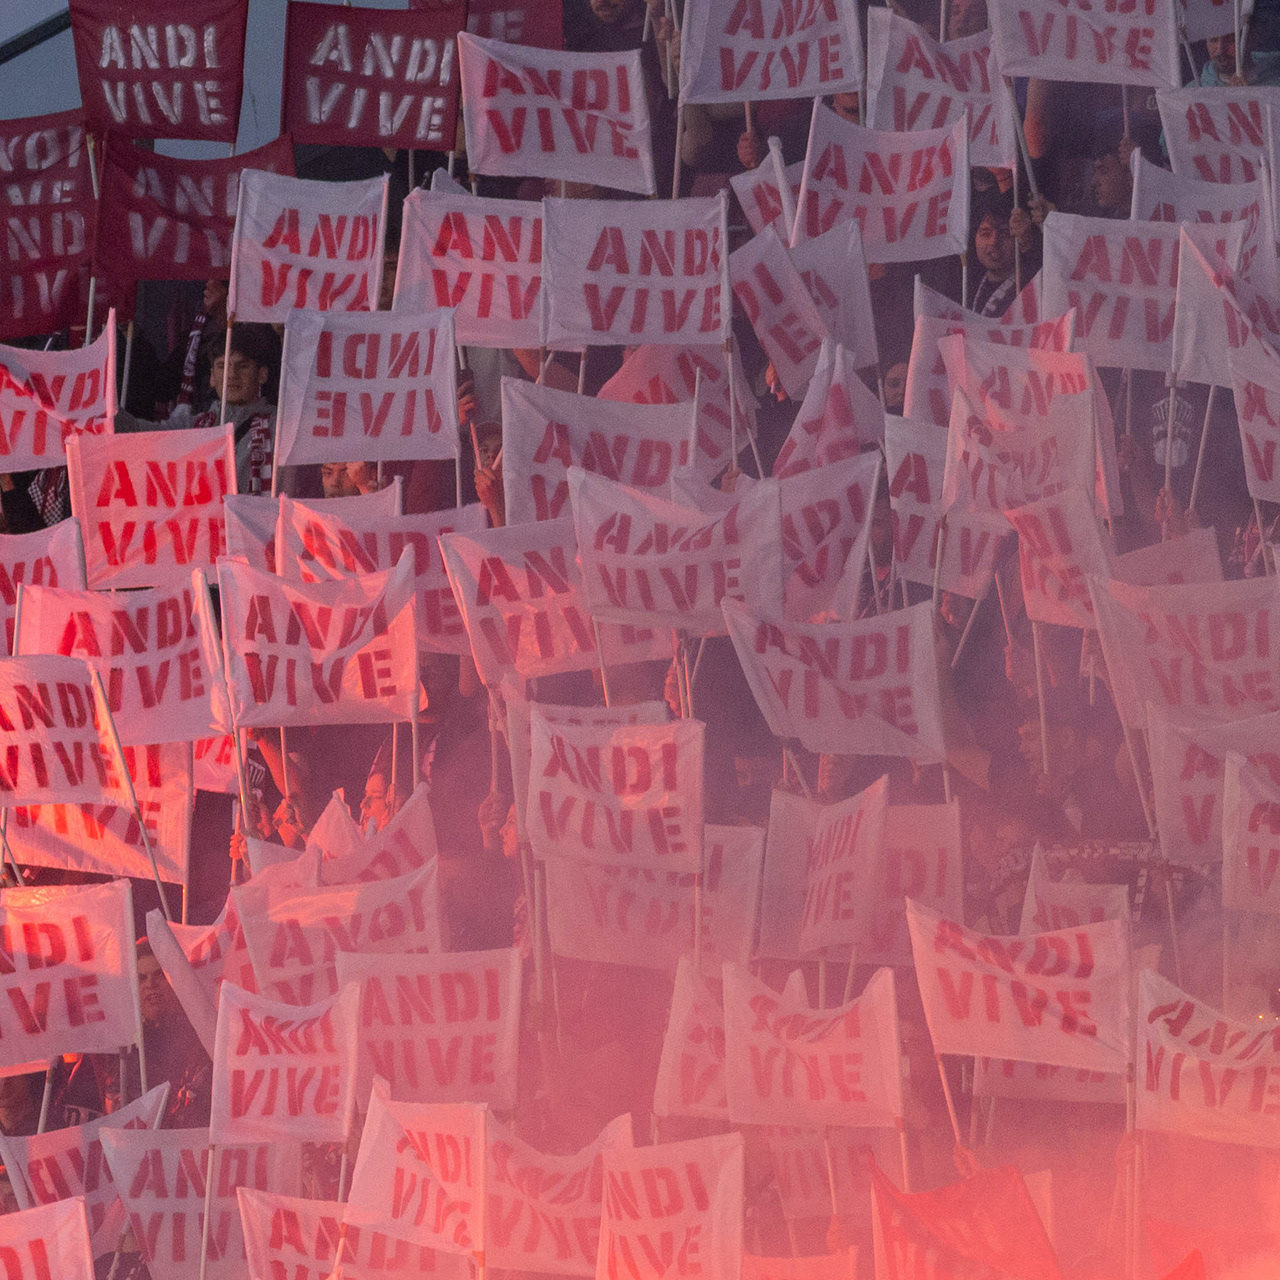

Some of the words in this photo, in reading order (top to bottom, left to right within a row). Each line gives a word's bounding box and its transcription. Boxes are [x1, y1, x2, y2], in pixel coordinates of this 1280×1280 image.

[102, 24, 220, 68] ANDI
[311, 25, 454, 86] ANDI
[721, 36, 842, 91] VIVE
[1020, 12, 1155, 70] VIVE
[100, 80, 226, 125] VIVE
[306, 76, 445, 141] VIVE
[482, 61, 632, 112] ANDI
[486, 108, 638, 158] VIVE
[262, 208, 378, 261] ANDI
[805, 192, 950, 244] VIVE
[260, 260, 371, 311] VIV
[584, 284, 721, 332] VIVE
[58, 588, 199, 656] ANDI
[246, 595, 388, 650] ANDI
[244, 650, 396, 705] VIVE
[755, 622, 911, 682] ANDI
[108, 650, 205, 712] IVE
[542, 735, 678, 794] ANDI
[539, 792, 688, 855] VIVE
[362, 971, 500, 1028] ANDI
[365, 1034, 498, 1088] VIVE
[230, 1066, 341, 1119] VIVE
[129, 1148, 268, 1199] ANDI
[608, 1162, 710, 1221] NDI
[130, 1210, 245, 1262] VIV
